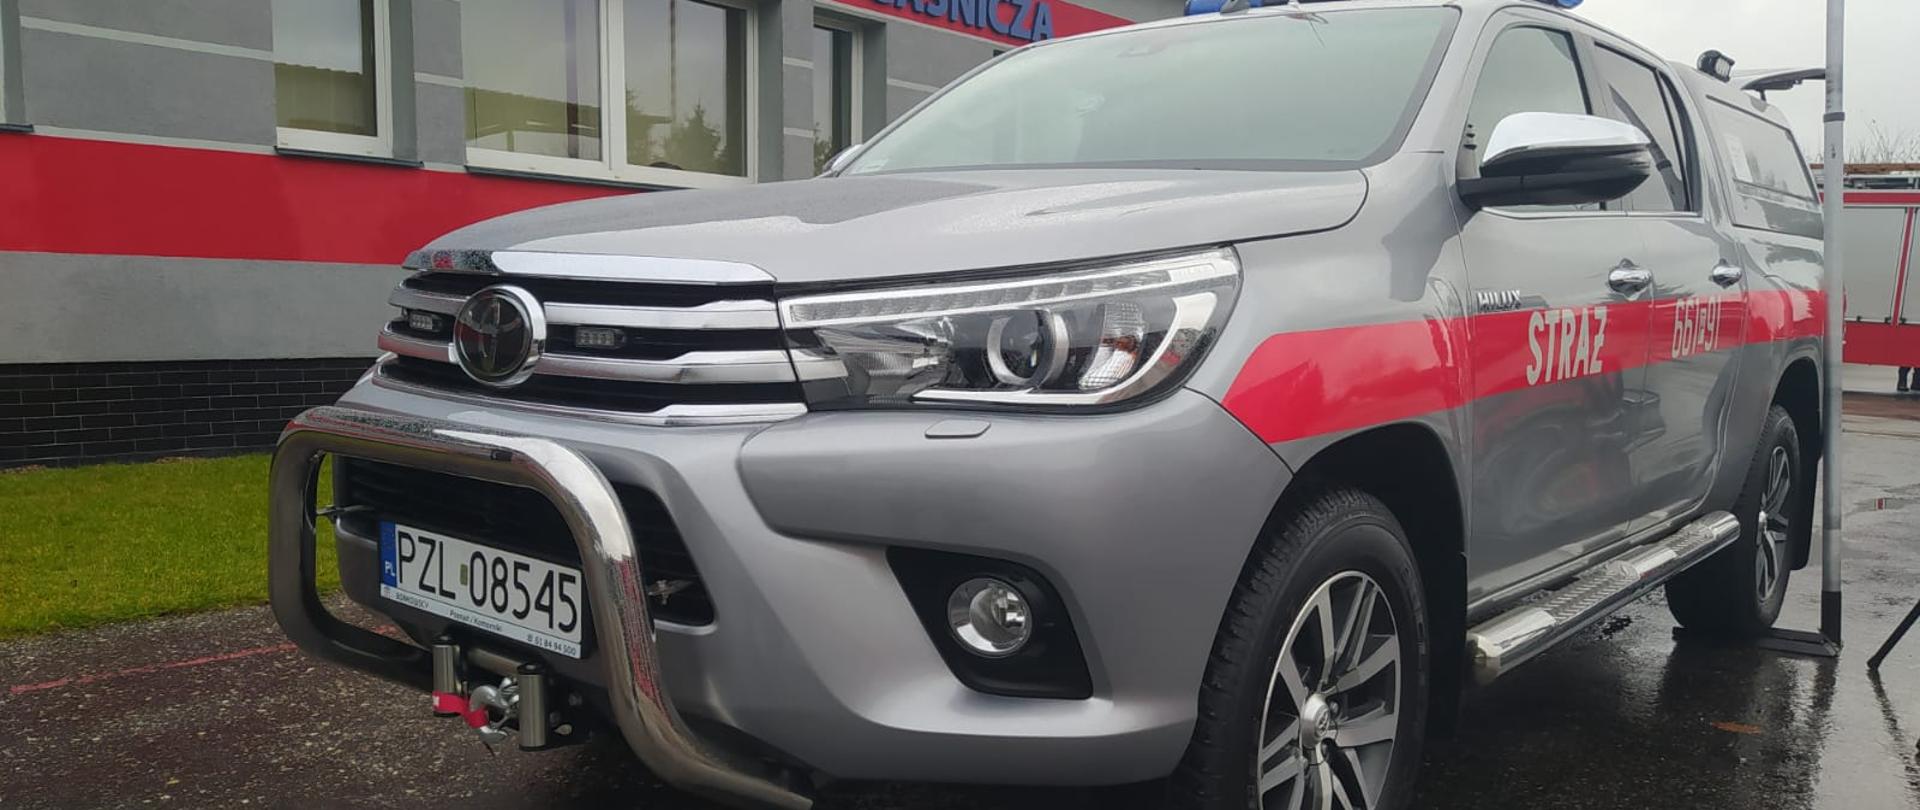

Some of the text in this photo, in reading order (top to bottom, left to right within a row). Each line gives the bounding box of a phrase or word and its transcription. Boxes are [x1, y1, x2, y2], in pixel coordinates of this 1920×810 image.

[1477, 289, 1520, 304] HILUX
[384, 560, 396, 577] PL
[398, 530, 578, 634] PZL 08545
